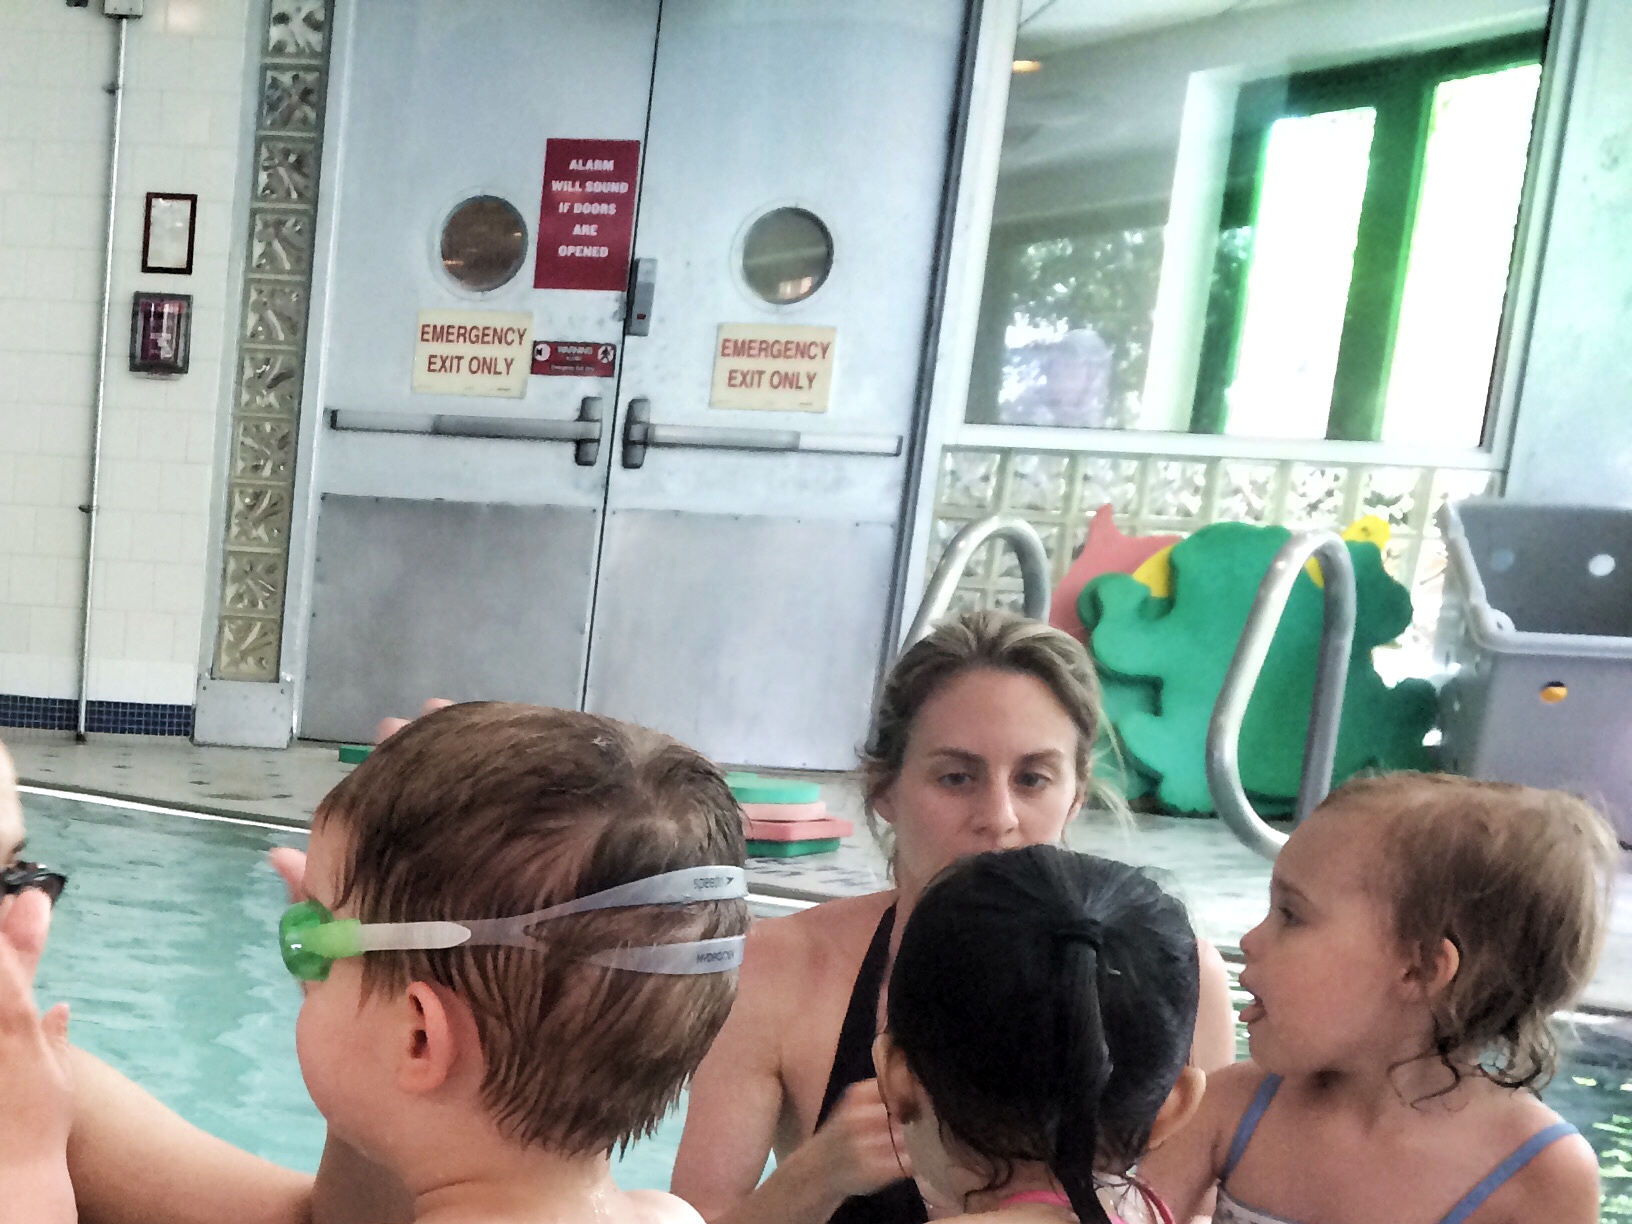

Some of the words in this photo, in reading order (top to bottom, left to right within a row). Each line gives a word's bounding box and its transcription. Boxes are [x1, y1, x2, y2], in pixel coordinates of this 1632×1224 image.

[569, 159, 614, 171] ALARM
[551, 180, 582, 192] WILL
[585, 181, 629, 193] SOUND
[558, 202, 571, 213] IF
[573, 202, 617, 215] DOORS
[572, 224, 598, 236] ARE
[558, 245, 609, 257] OPENED
[420, 323, 528, 345] EMERGENCY
[720, 338, 831, 360] EMERGENCY
[427, 354, 465, 374] EXIT
[468, 356, 515, 376] ONLY
[727, 369, 766, 389] EXIT
[769, 370, 817, 390] ONLY
